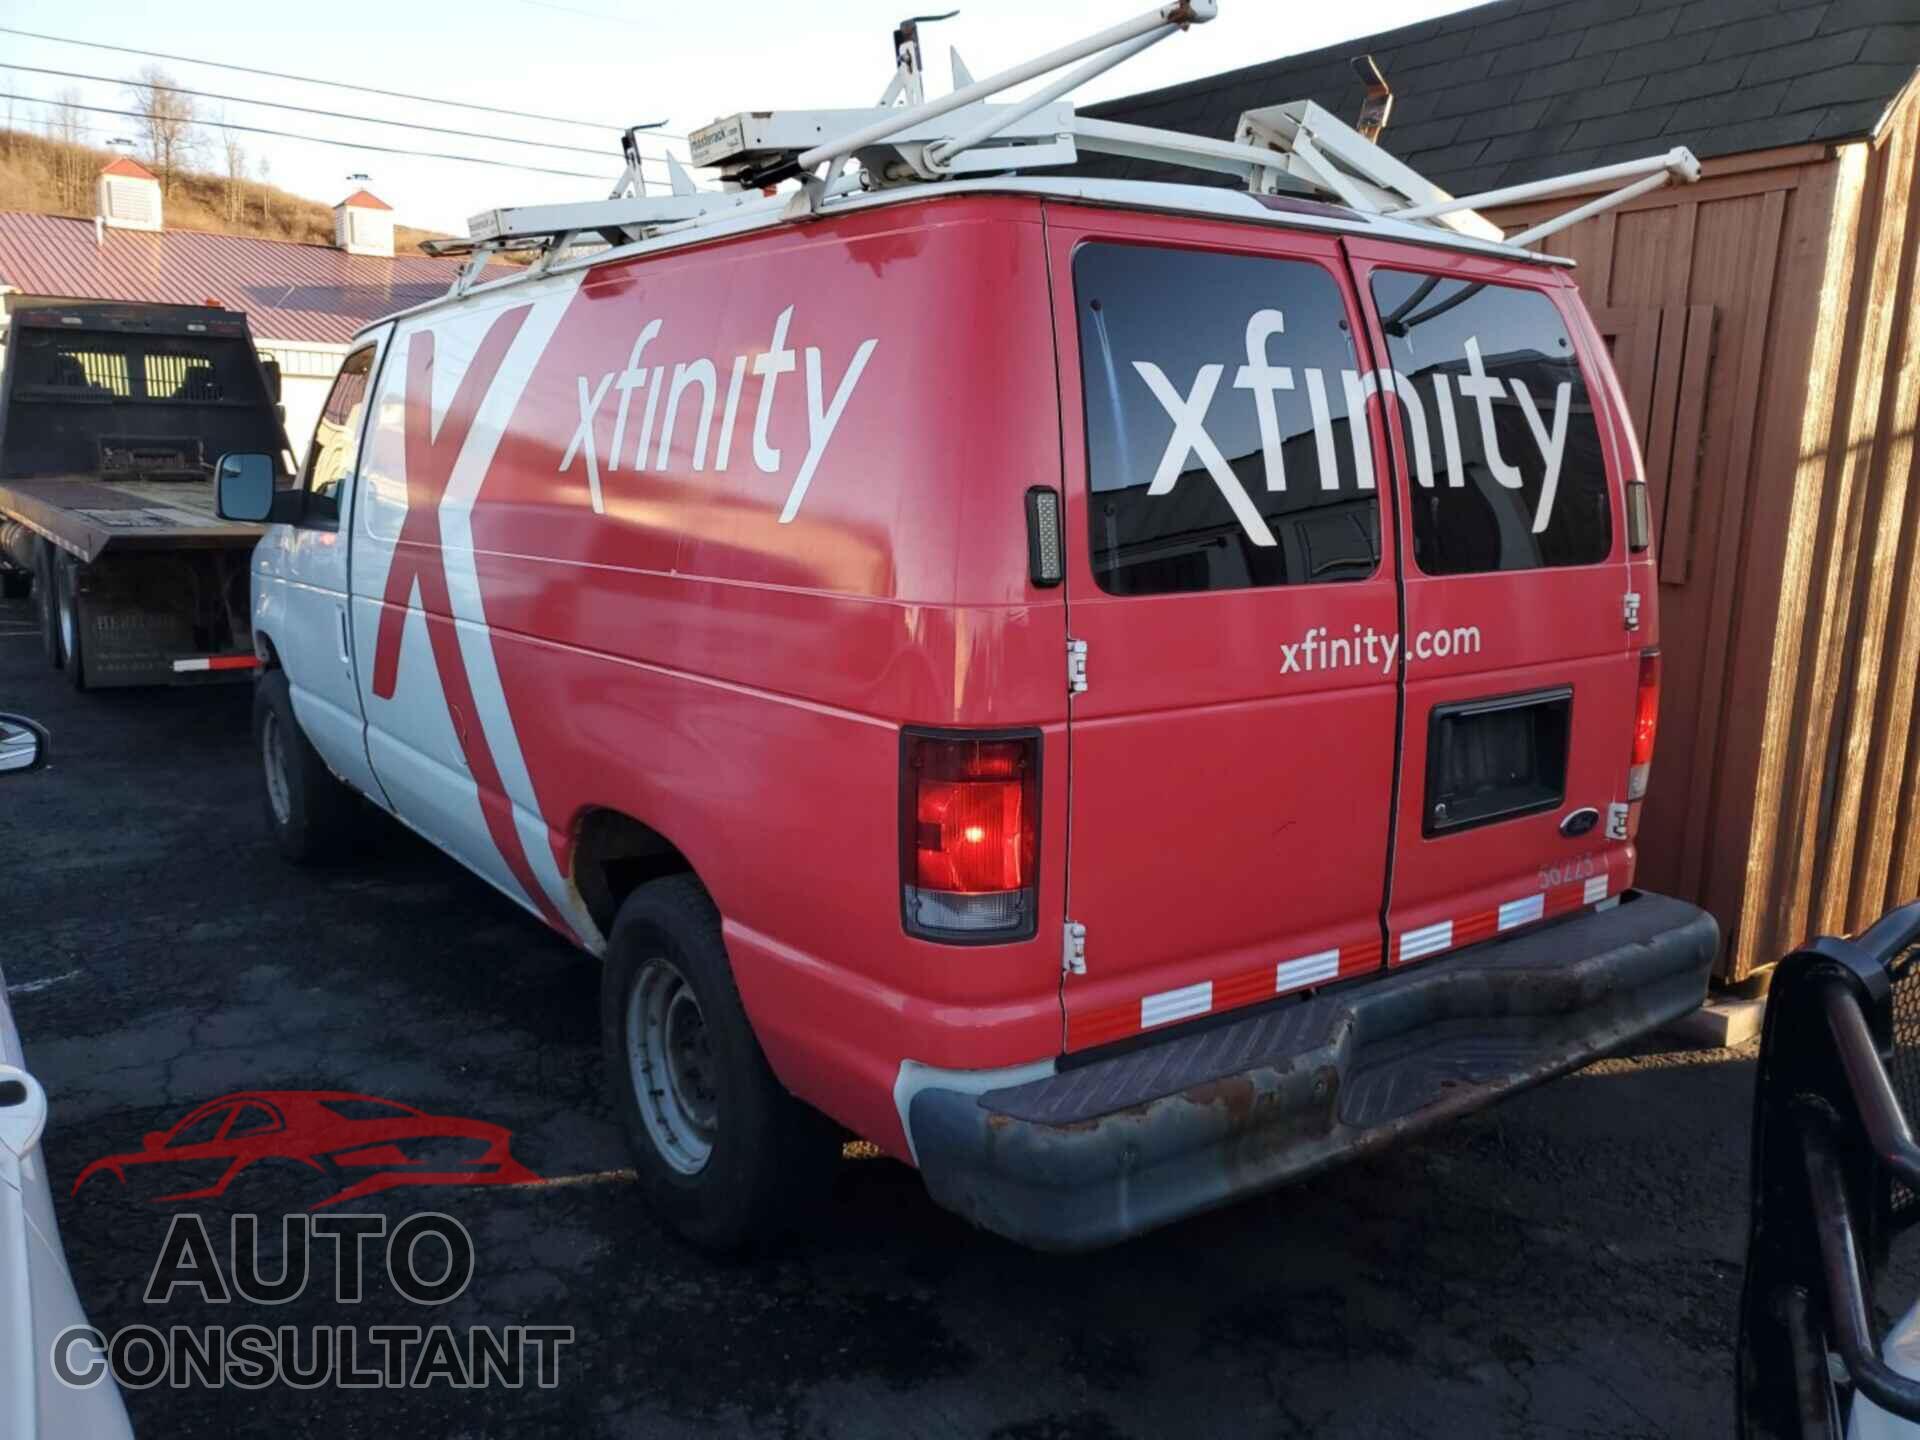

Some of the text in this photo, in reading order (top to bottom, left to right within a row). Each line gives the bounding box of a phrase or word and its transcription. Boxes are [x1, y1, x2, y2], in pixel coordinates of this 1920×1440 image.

[558, 304, 879, 523] xfinity
[1131, 308, 1572, 547] xfinity
[1279, 624, 1481, 674] xfinity.com
